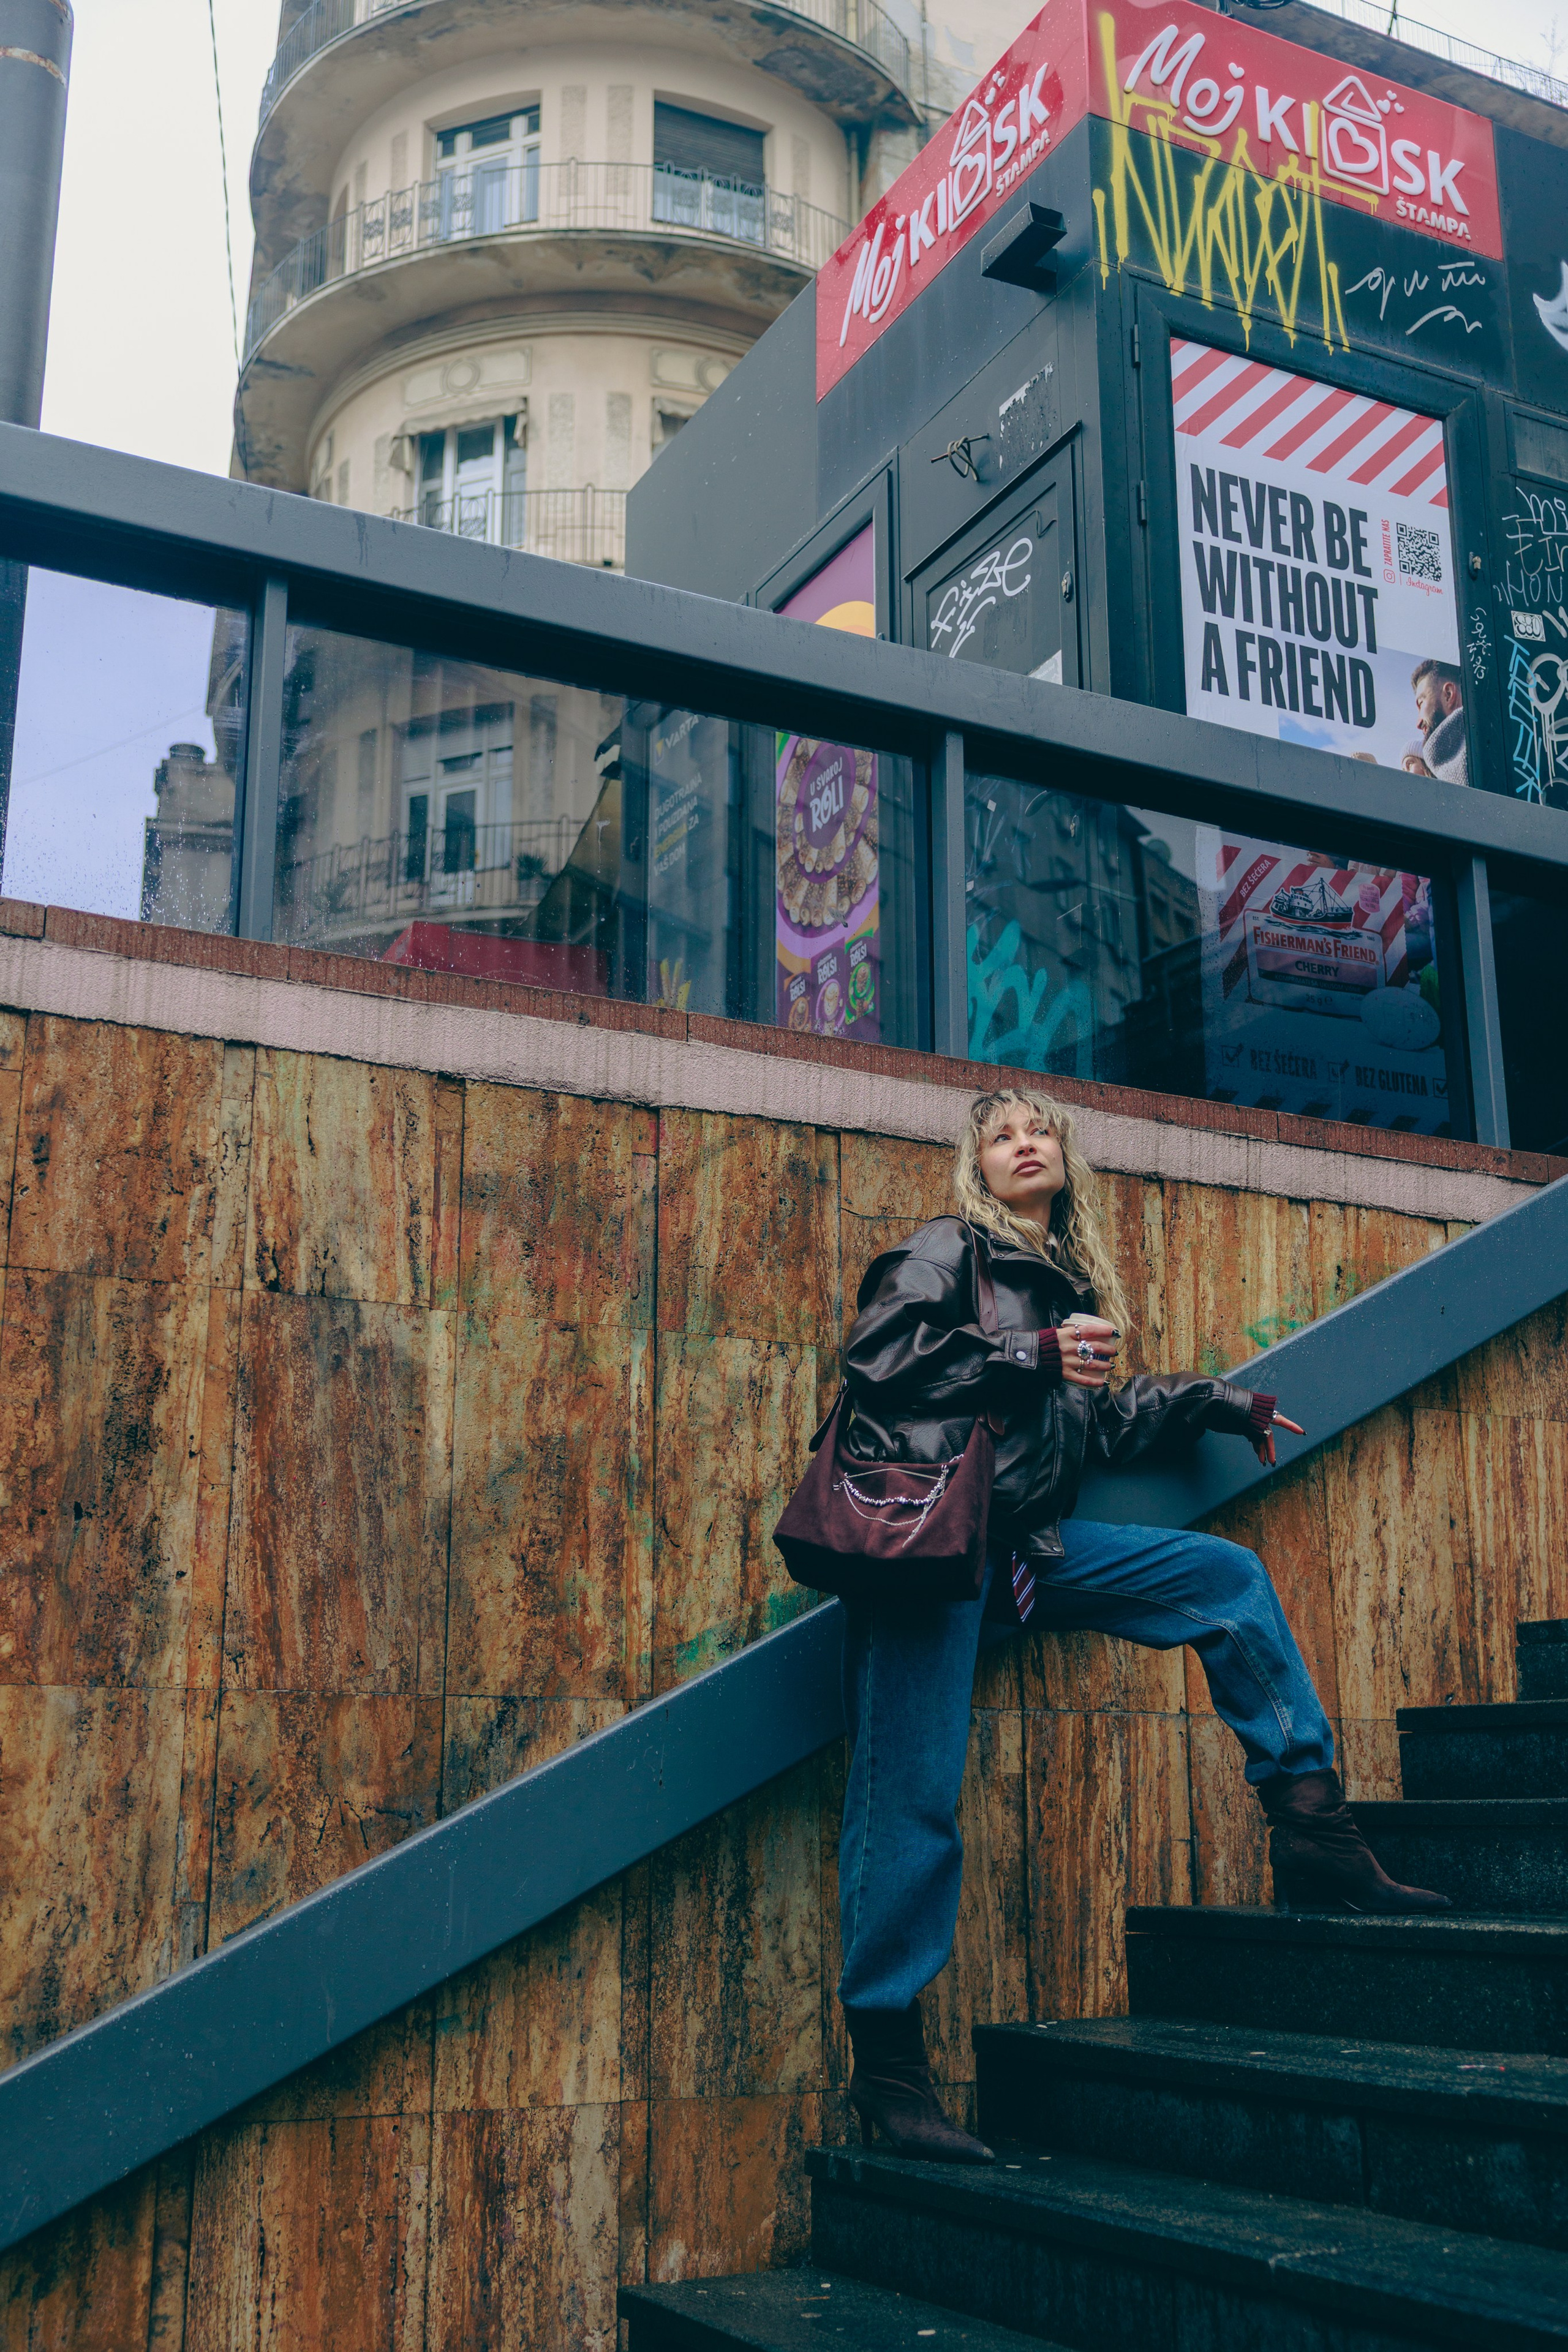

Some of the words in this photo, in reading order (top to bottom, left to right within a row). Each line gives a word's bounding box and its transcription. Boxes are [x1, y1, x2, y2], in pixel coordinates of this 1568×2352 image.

[995, 128, 1051, 198] ŠTAMPA
[1396, 195, 1471, 241] ŠTAMPA
[1190, 463, 1318, 564] NEVER
[1322, 500, 1372, 579] BE
[1381, 519, 1390, 532] NAS
[1382, 533, 1393, 566] ZAPRATITE
[1193, 540, 1379, 655] WITHOUT
[1406, 577, 1444, 597] Instagram
[1201, 621, 1230, 697] A
[1235, 628, 1376, 729] FRIEND
[665, 714, 699, 749] VARTA
[810, 781, 815, 796] U
[816, 756, 843, 791] SVAKOJ
[688, 813, 699, 830] ZA
[1240, 881, 1251, 898] BEZ
[1253, 925, 1332, 956] FISHERMAN'S
[1333, 939, 1376, 963] FRIEND
[1295, 960, 1340, 978] CHERRY
[1305, 993, 1315, 1003] 25
[1355, 1066, 1376, 1088] BEZ
[1378, 1068, 1429, 1096] GLUTENA
